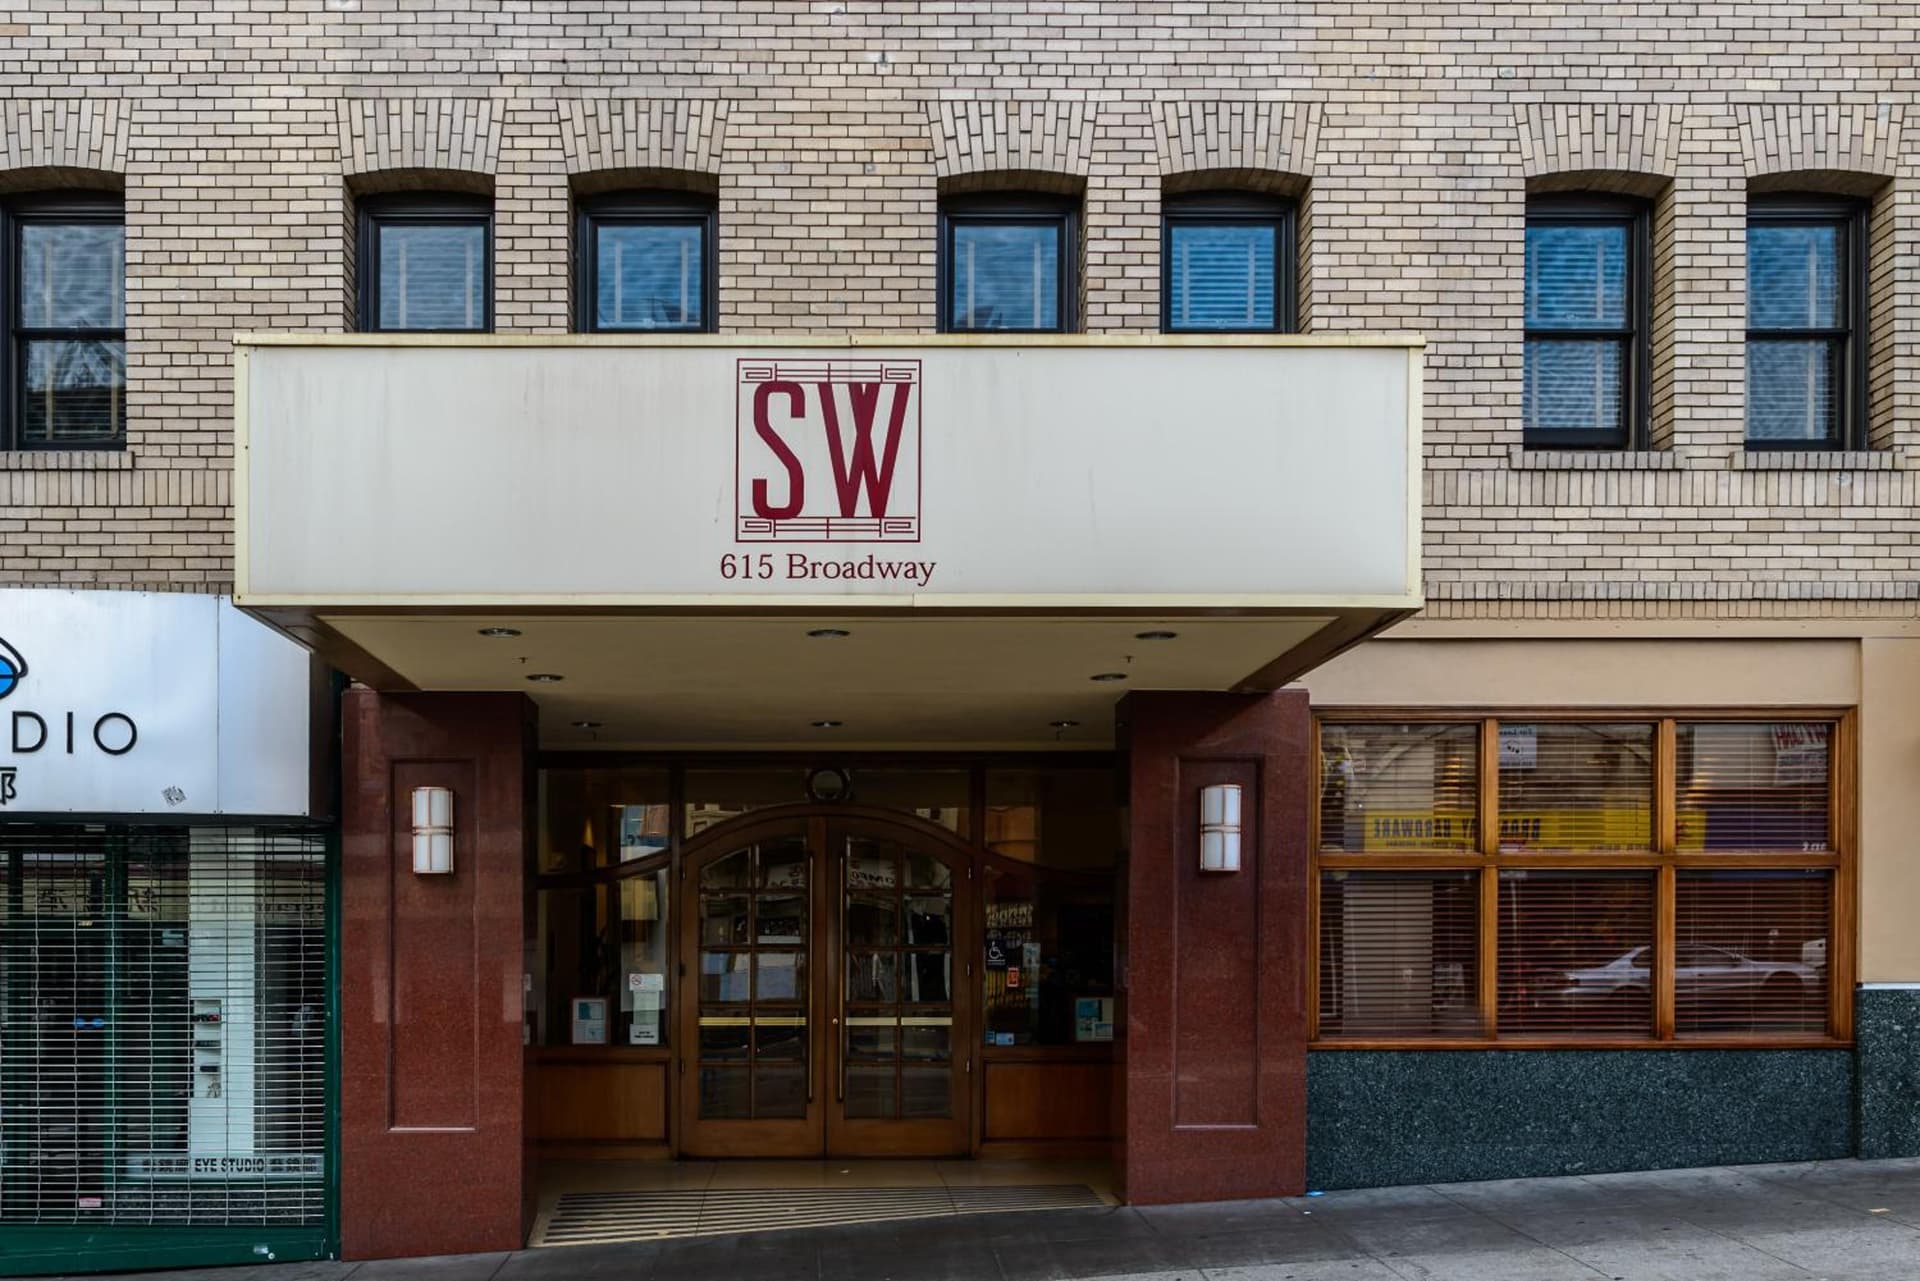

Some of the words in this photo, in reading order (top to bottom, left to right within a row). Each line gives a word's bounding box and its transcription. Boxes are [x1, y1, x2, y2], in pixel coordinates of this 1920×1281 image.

[752, 381, 911, 520] SW
[720, 553, 773, 579] 615
[786, 553, 936, 587] Broadway
[195, 1158, 217, 1172] EYE
[221, 1158, 265, 1172] STUDIO
